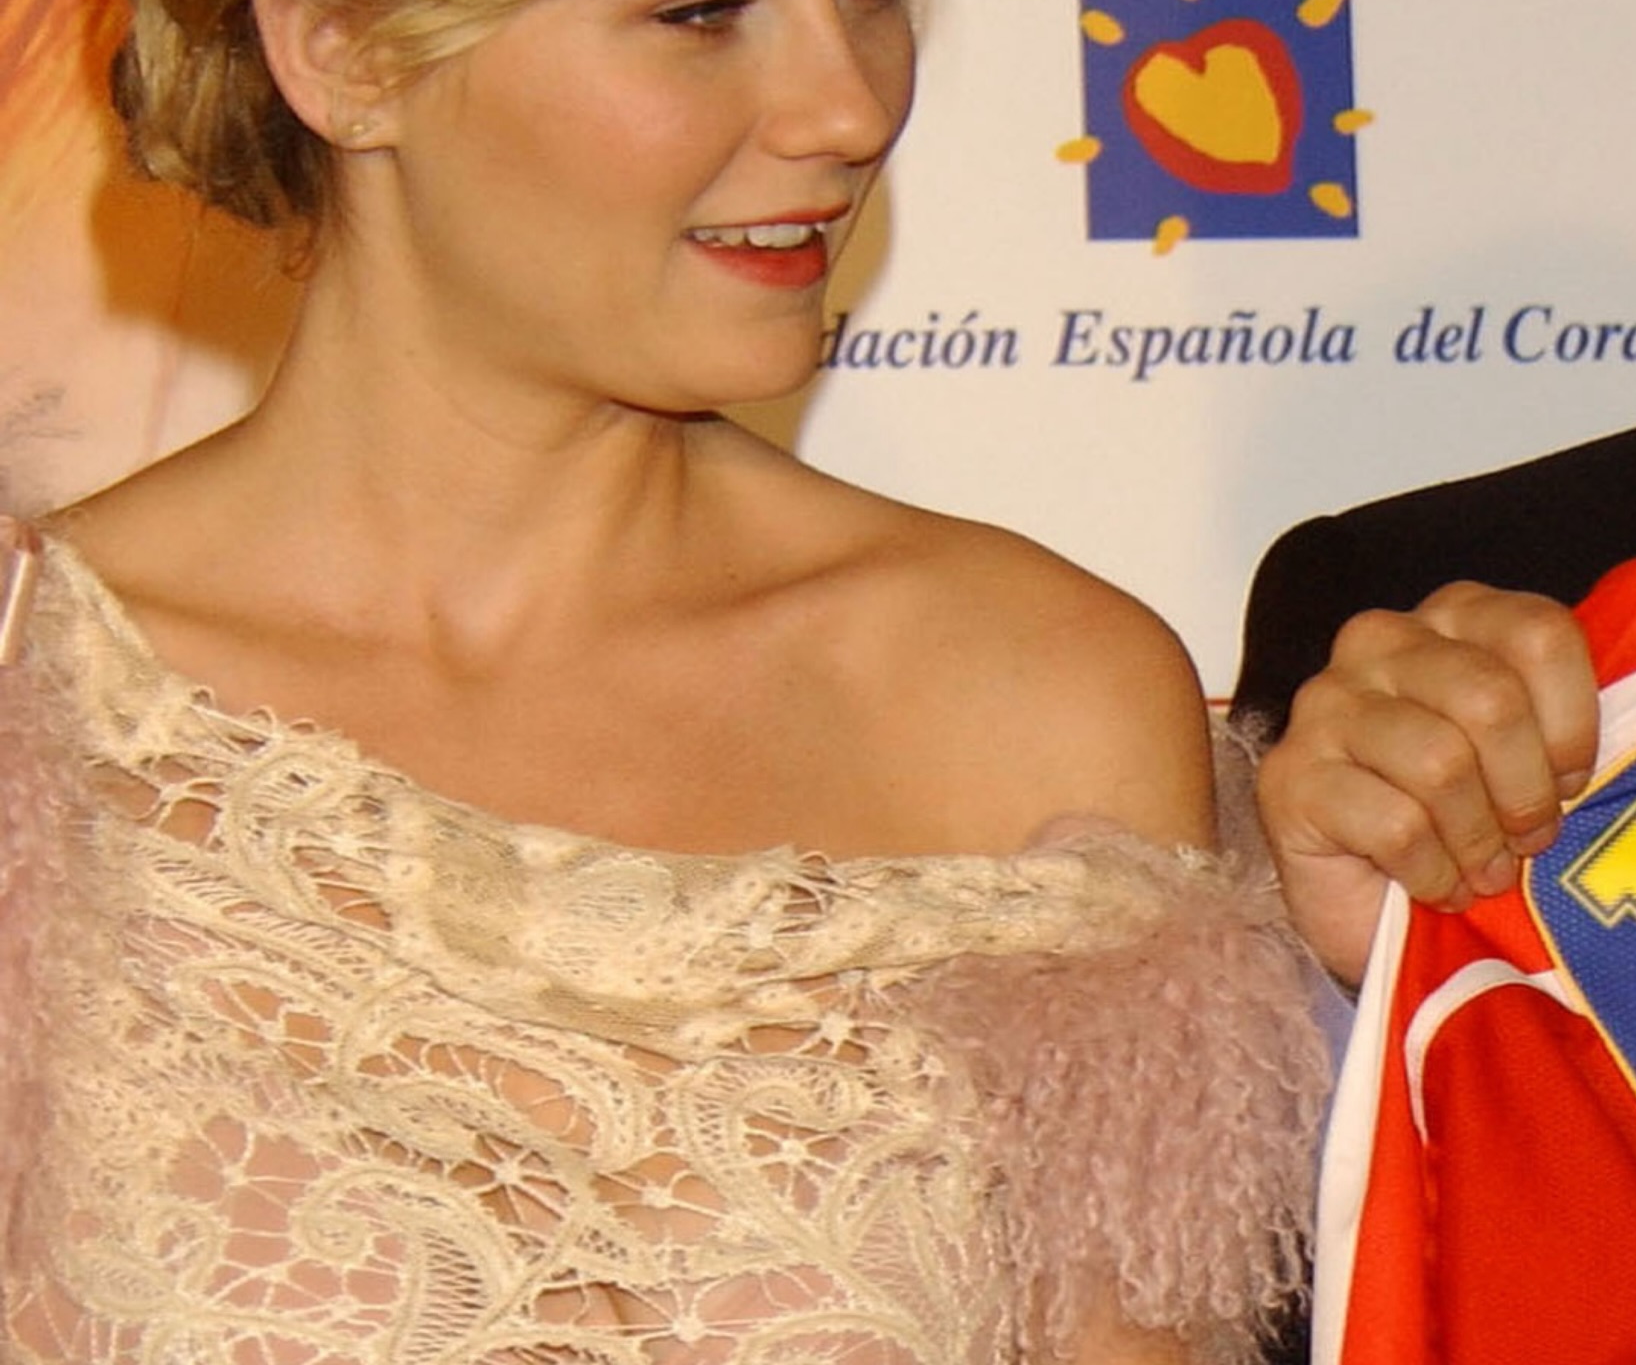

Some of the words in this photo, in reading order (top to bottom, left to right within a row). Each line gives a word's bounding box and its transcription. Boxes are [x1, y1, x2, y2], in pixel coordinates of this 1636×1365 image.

[818, 309, 1019, 369] dación
[1052, 306, 1356, 383] Española
[1394, 305, 1484, 365] del
